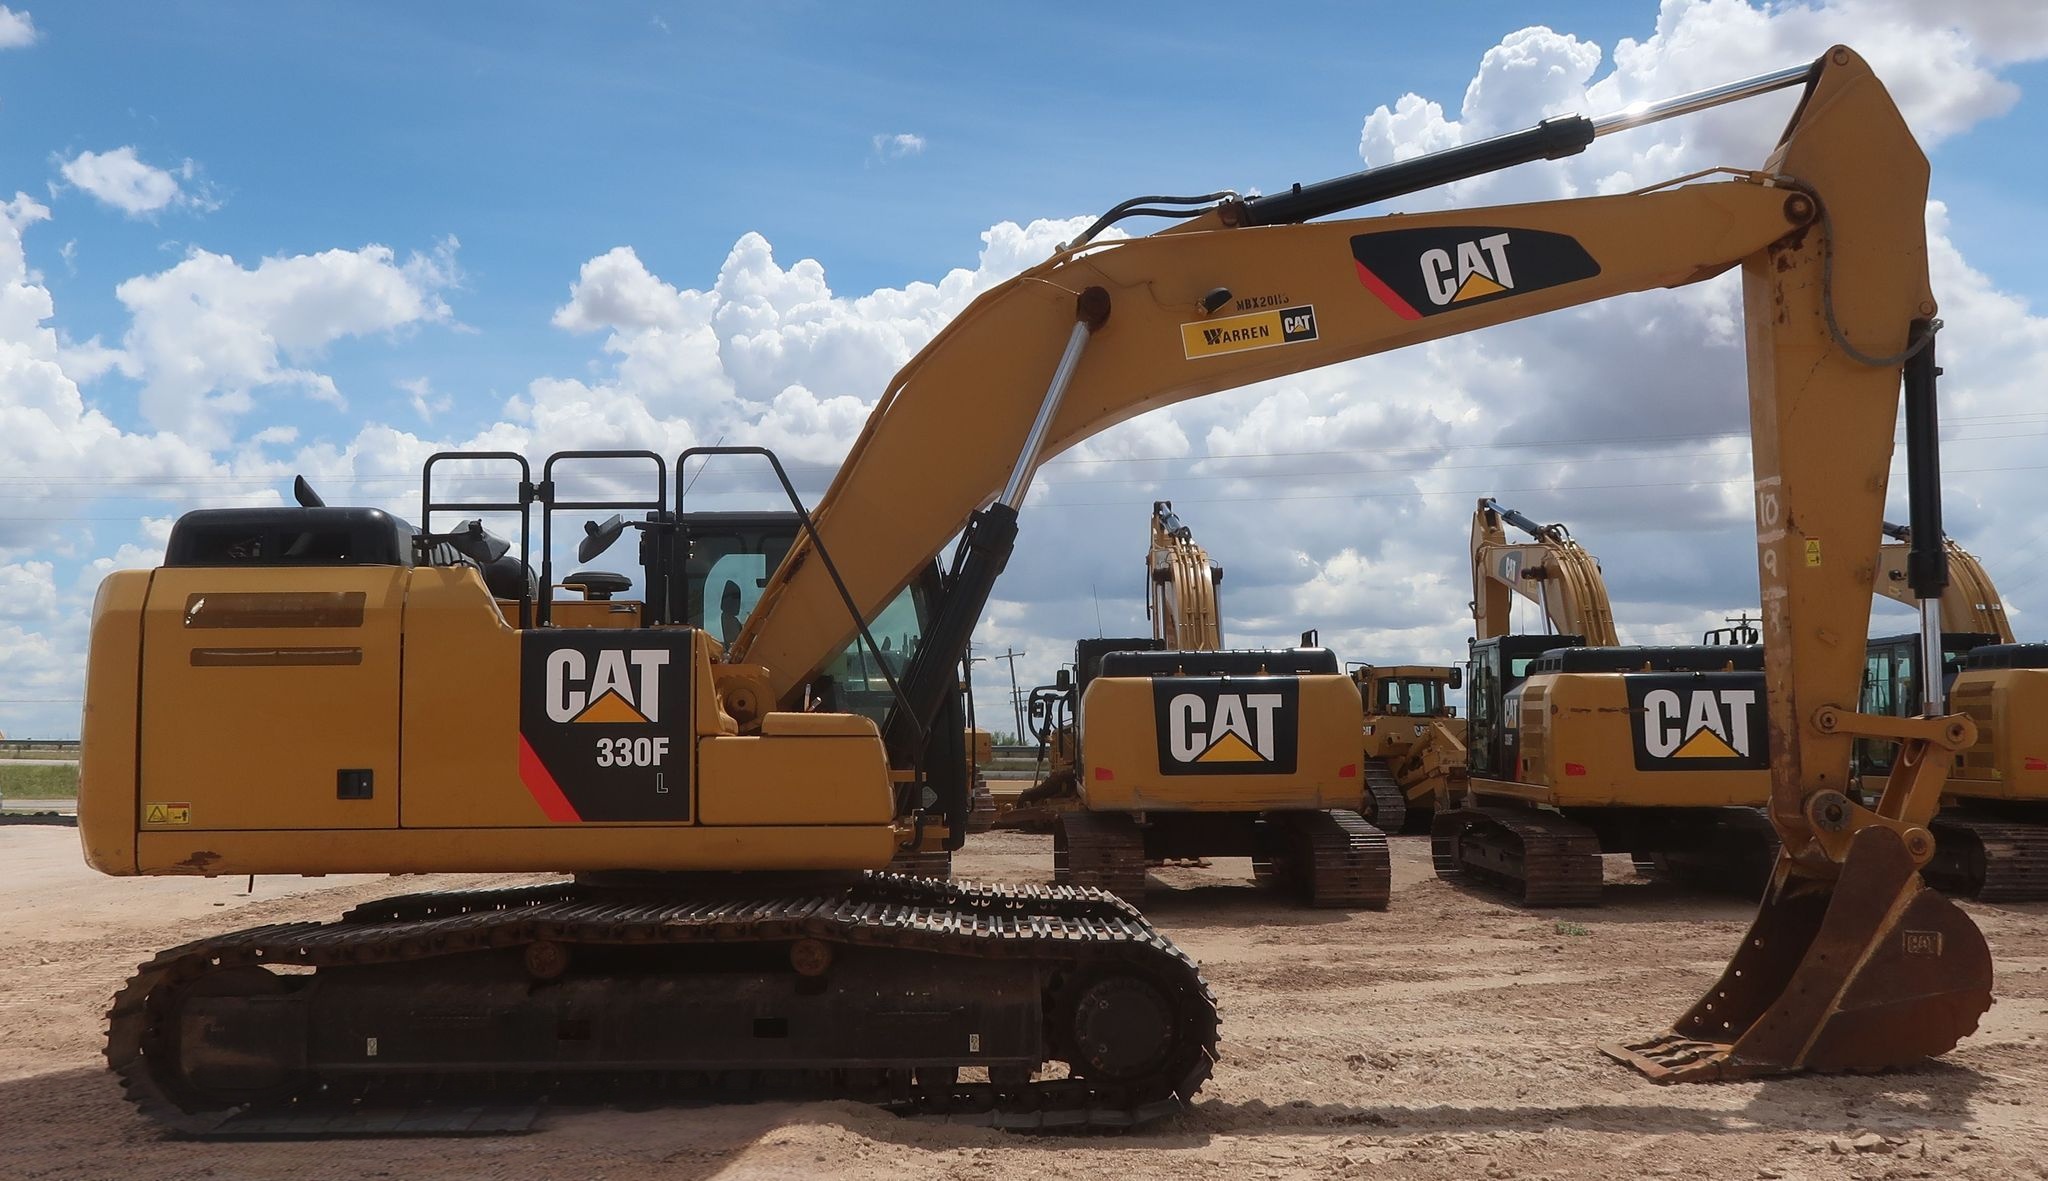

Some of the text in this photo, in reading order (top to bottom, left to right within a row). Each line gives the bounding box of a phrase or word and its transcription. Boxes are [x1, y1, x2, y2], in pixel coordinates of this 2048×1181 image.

[1419, 232, 1515, 306] CAT
[1203, 314, 1311, 346] WARREN CAT
[1760, 493, 1779, 527] 10
[1505, 556, 1516, 582] CAT
[1764, 549, 1777, 577] 9
[545, 648, 670, 723] CAT
[1169, 693, 1283, 762] CAT
[1504, 699, 1518, 728] CAT
[1643, 689, 1756, 758] CAT
[596, 737, 669, 768] 330F
[656, 772, 669, 794] L
